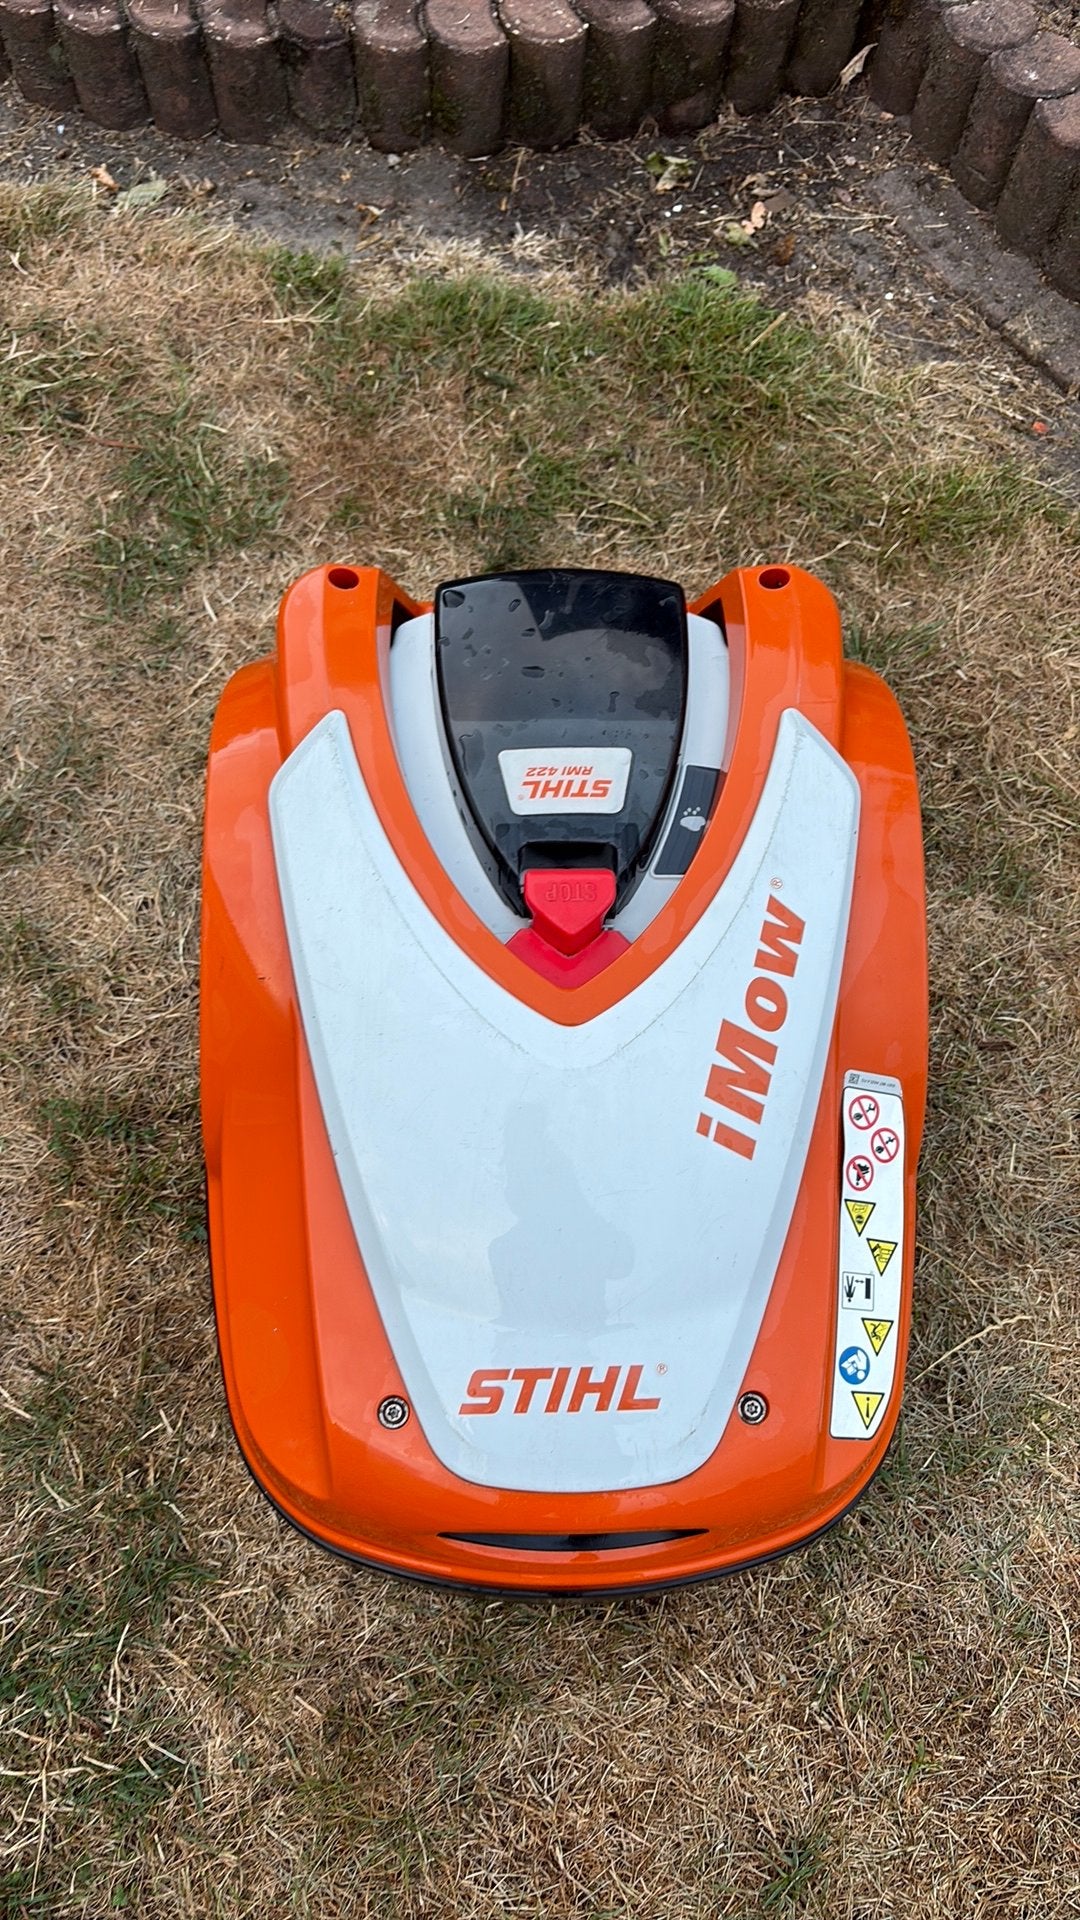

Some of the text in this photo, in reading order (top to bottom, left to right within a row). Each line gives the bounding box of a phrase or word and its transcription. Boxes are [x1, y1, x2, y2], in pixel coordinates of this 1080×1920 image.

[526, 766, 594, 777] RMI 422
[521, 779, 613, 799] STIHL
[545, 881, 598, 902] STOP
[695, 893, 806, 1161] iMow
[458, 1364, 661, 1415] STIHL
